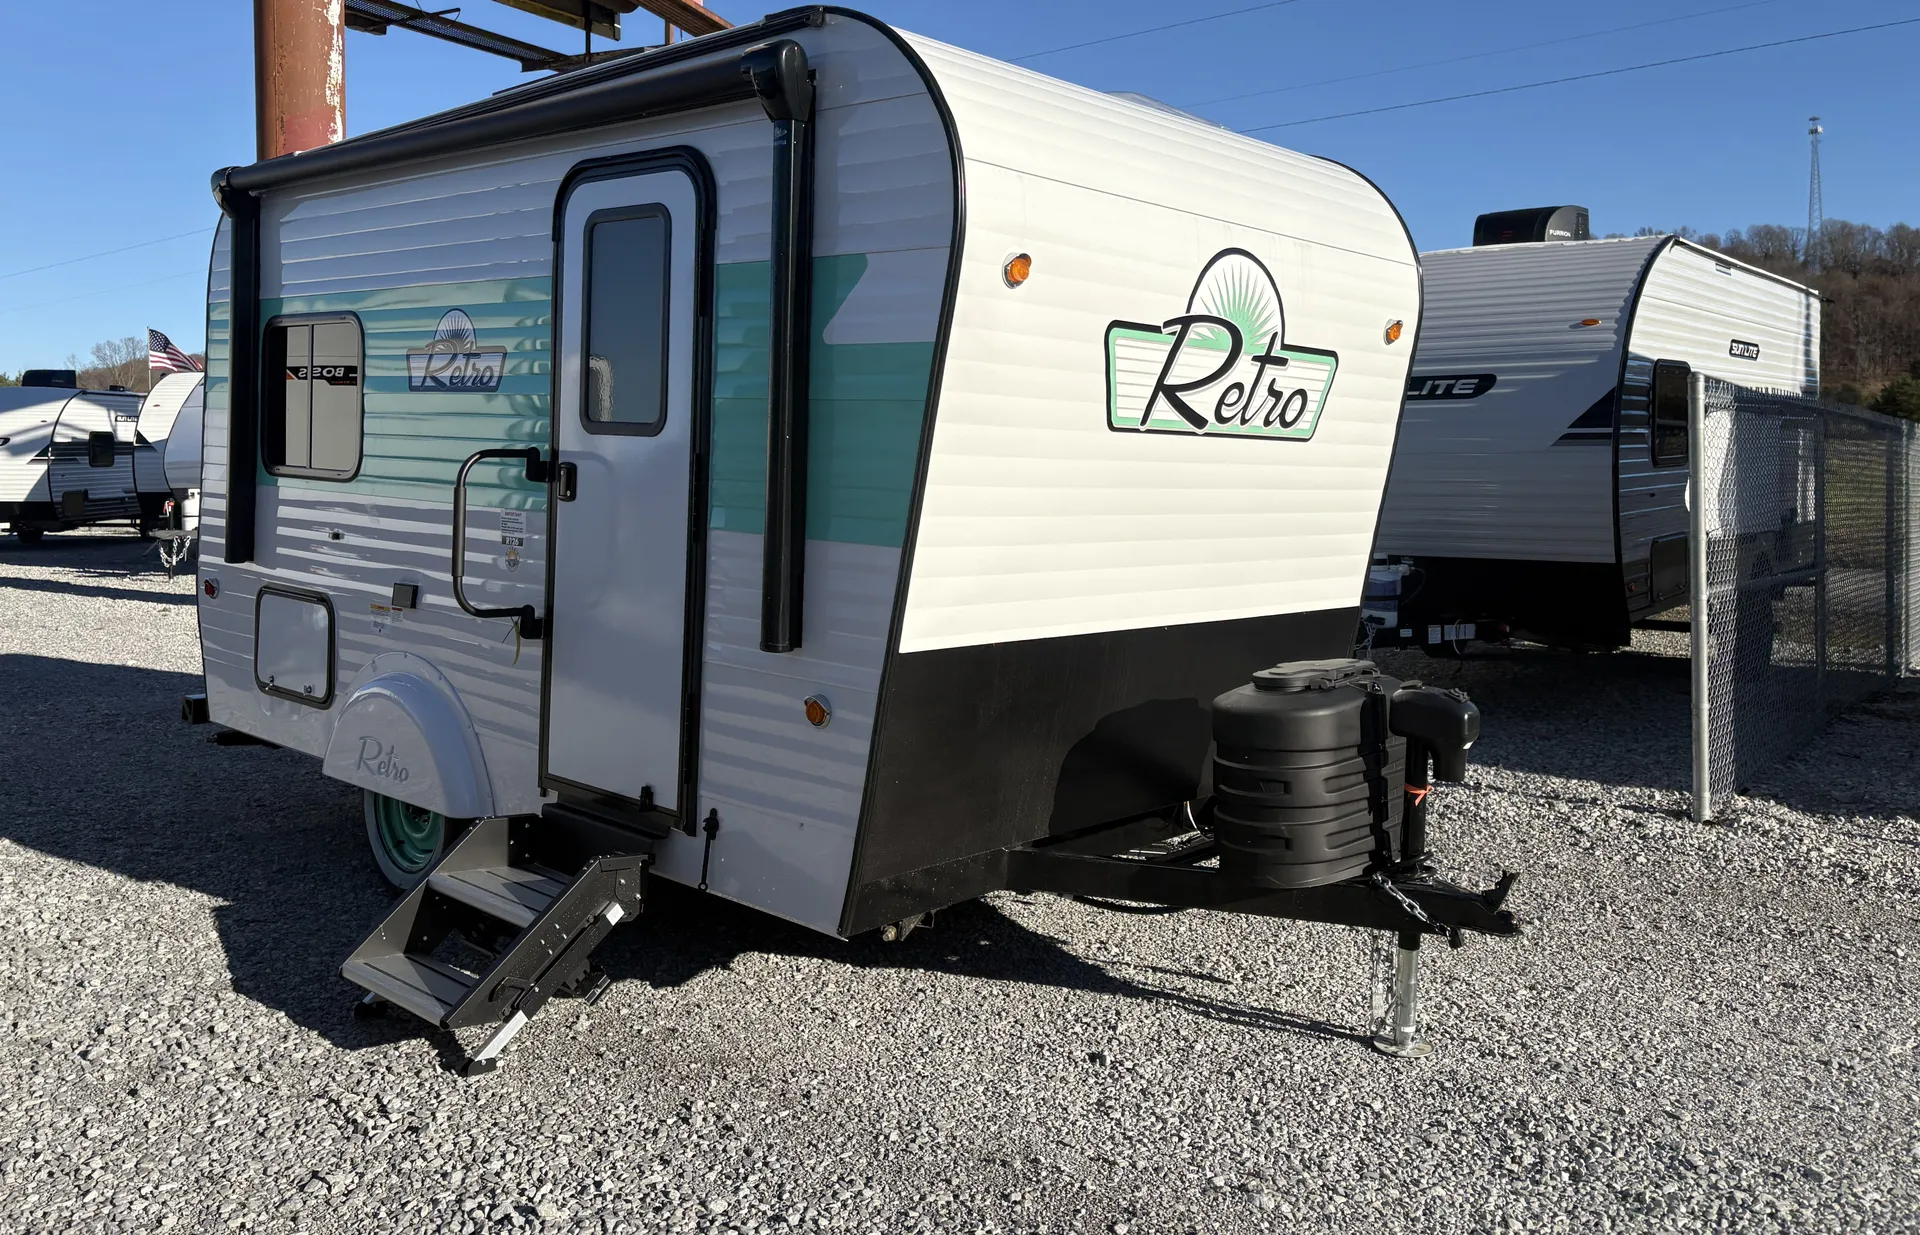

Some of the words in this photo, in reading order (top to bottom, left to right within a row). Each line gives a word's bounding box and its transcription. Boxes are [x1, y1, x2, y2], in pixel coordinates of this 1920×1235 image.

[420, 339, 495, 390] Retro
[1139, 313, 1309, 431] Retro
[356, 735, 410, 783] Retro
